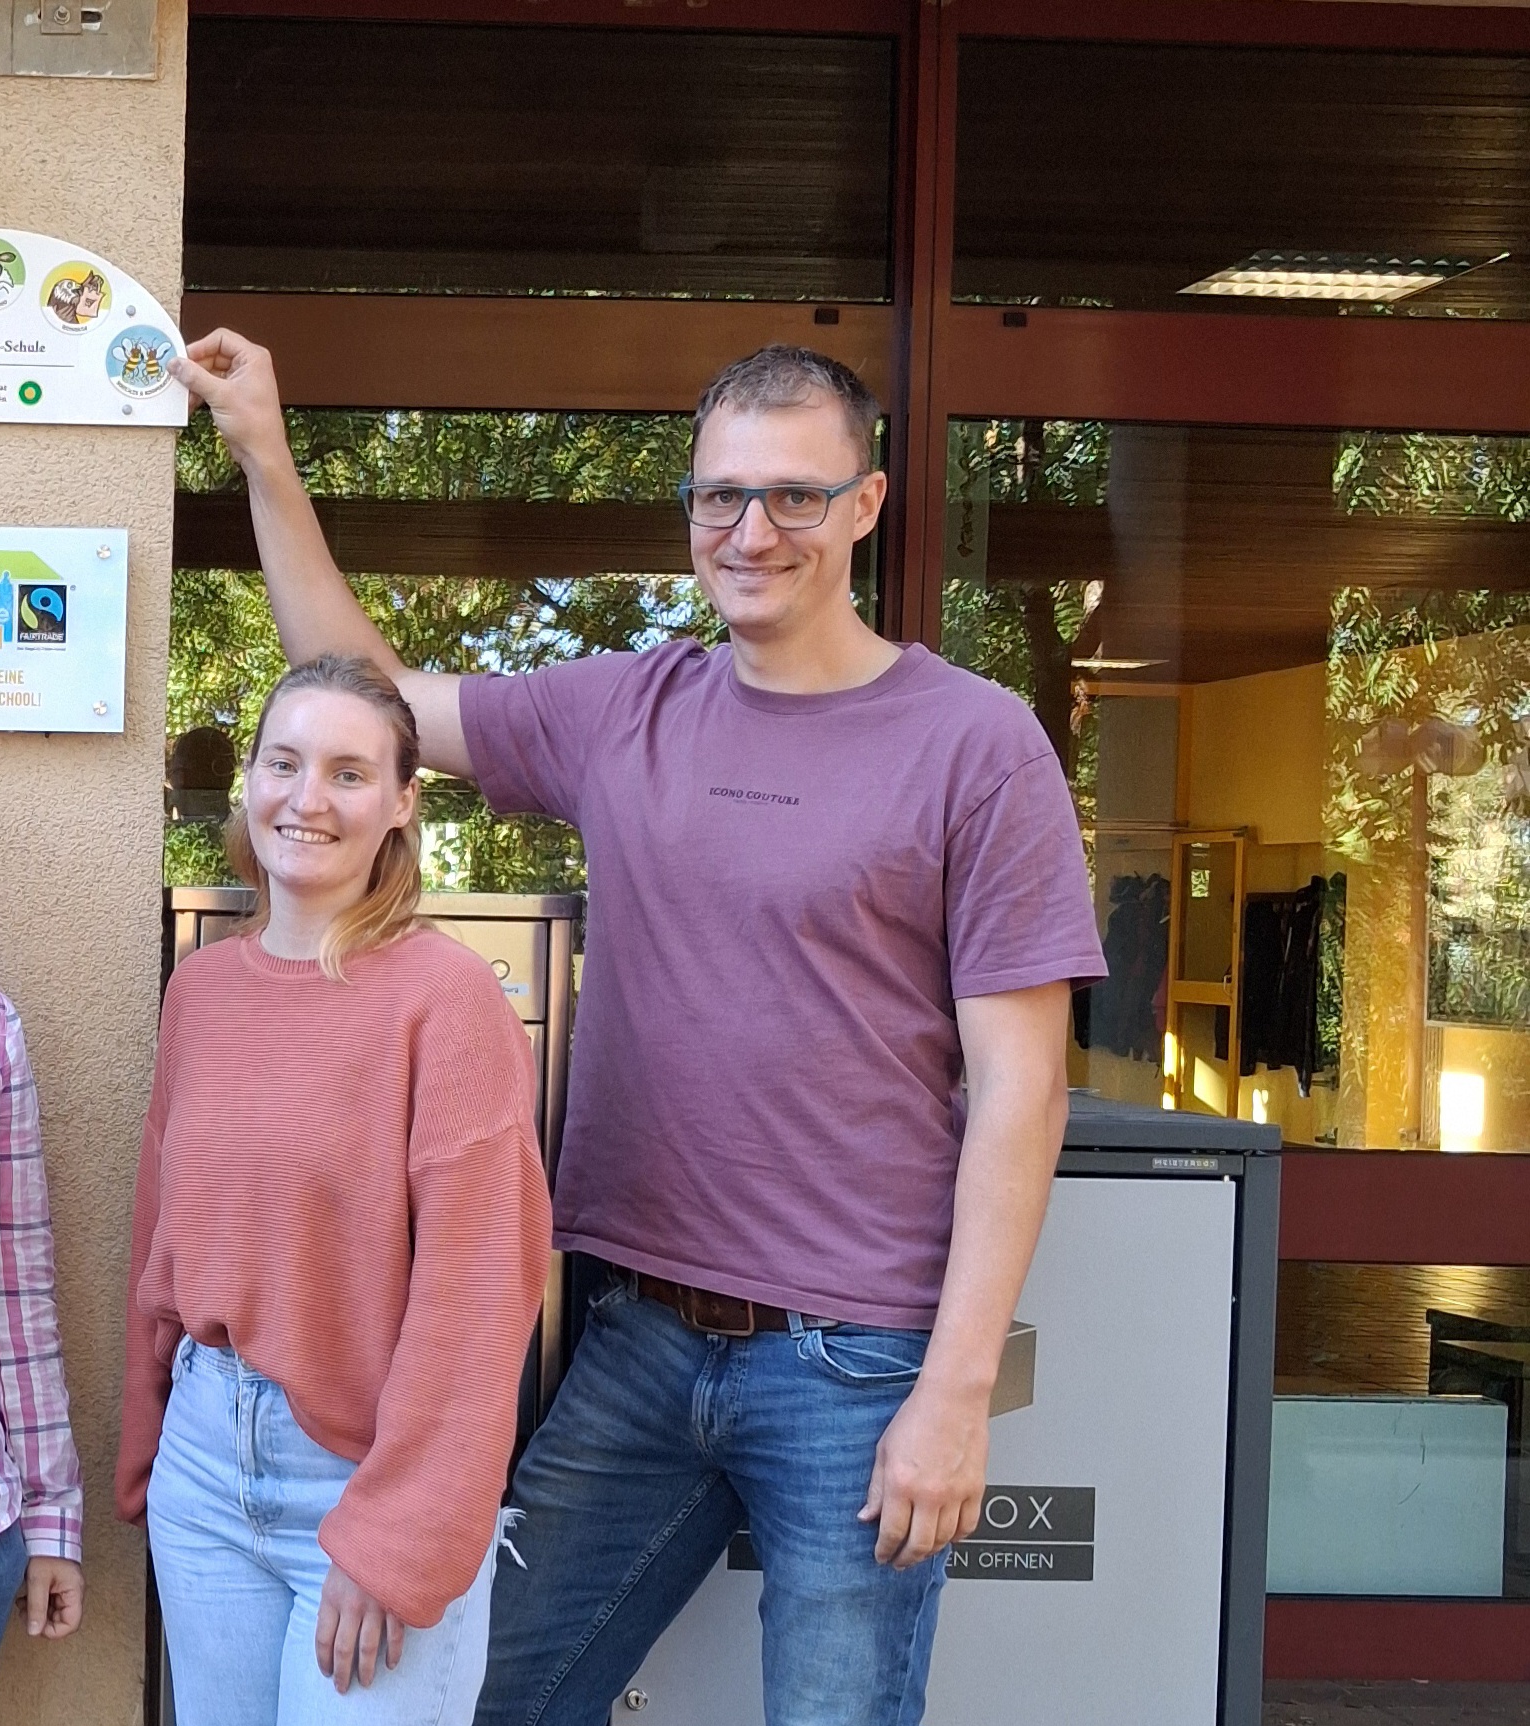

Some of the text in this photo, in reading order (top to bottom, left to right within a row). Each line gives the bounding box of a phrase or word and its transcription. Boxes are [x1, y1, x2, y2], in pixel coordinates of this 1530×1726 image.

[19, 631, 65, 642] FAIRTRADE
[985, 1495, 1053, 1530] OX
[945, 1550, 970, 1568] EN
